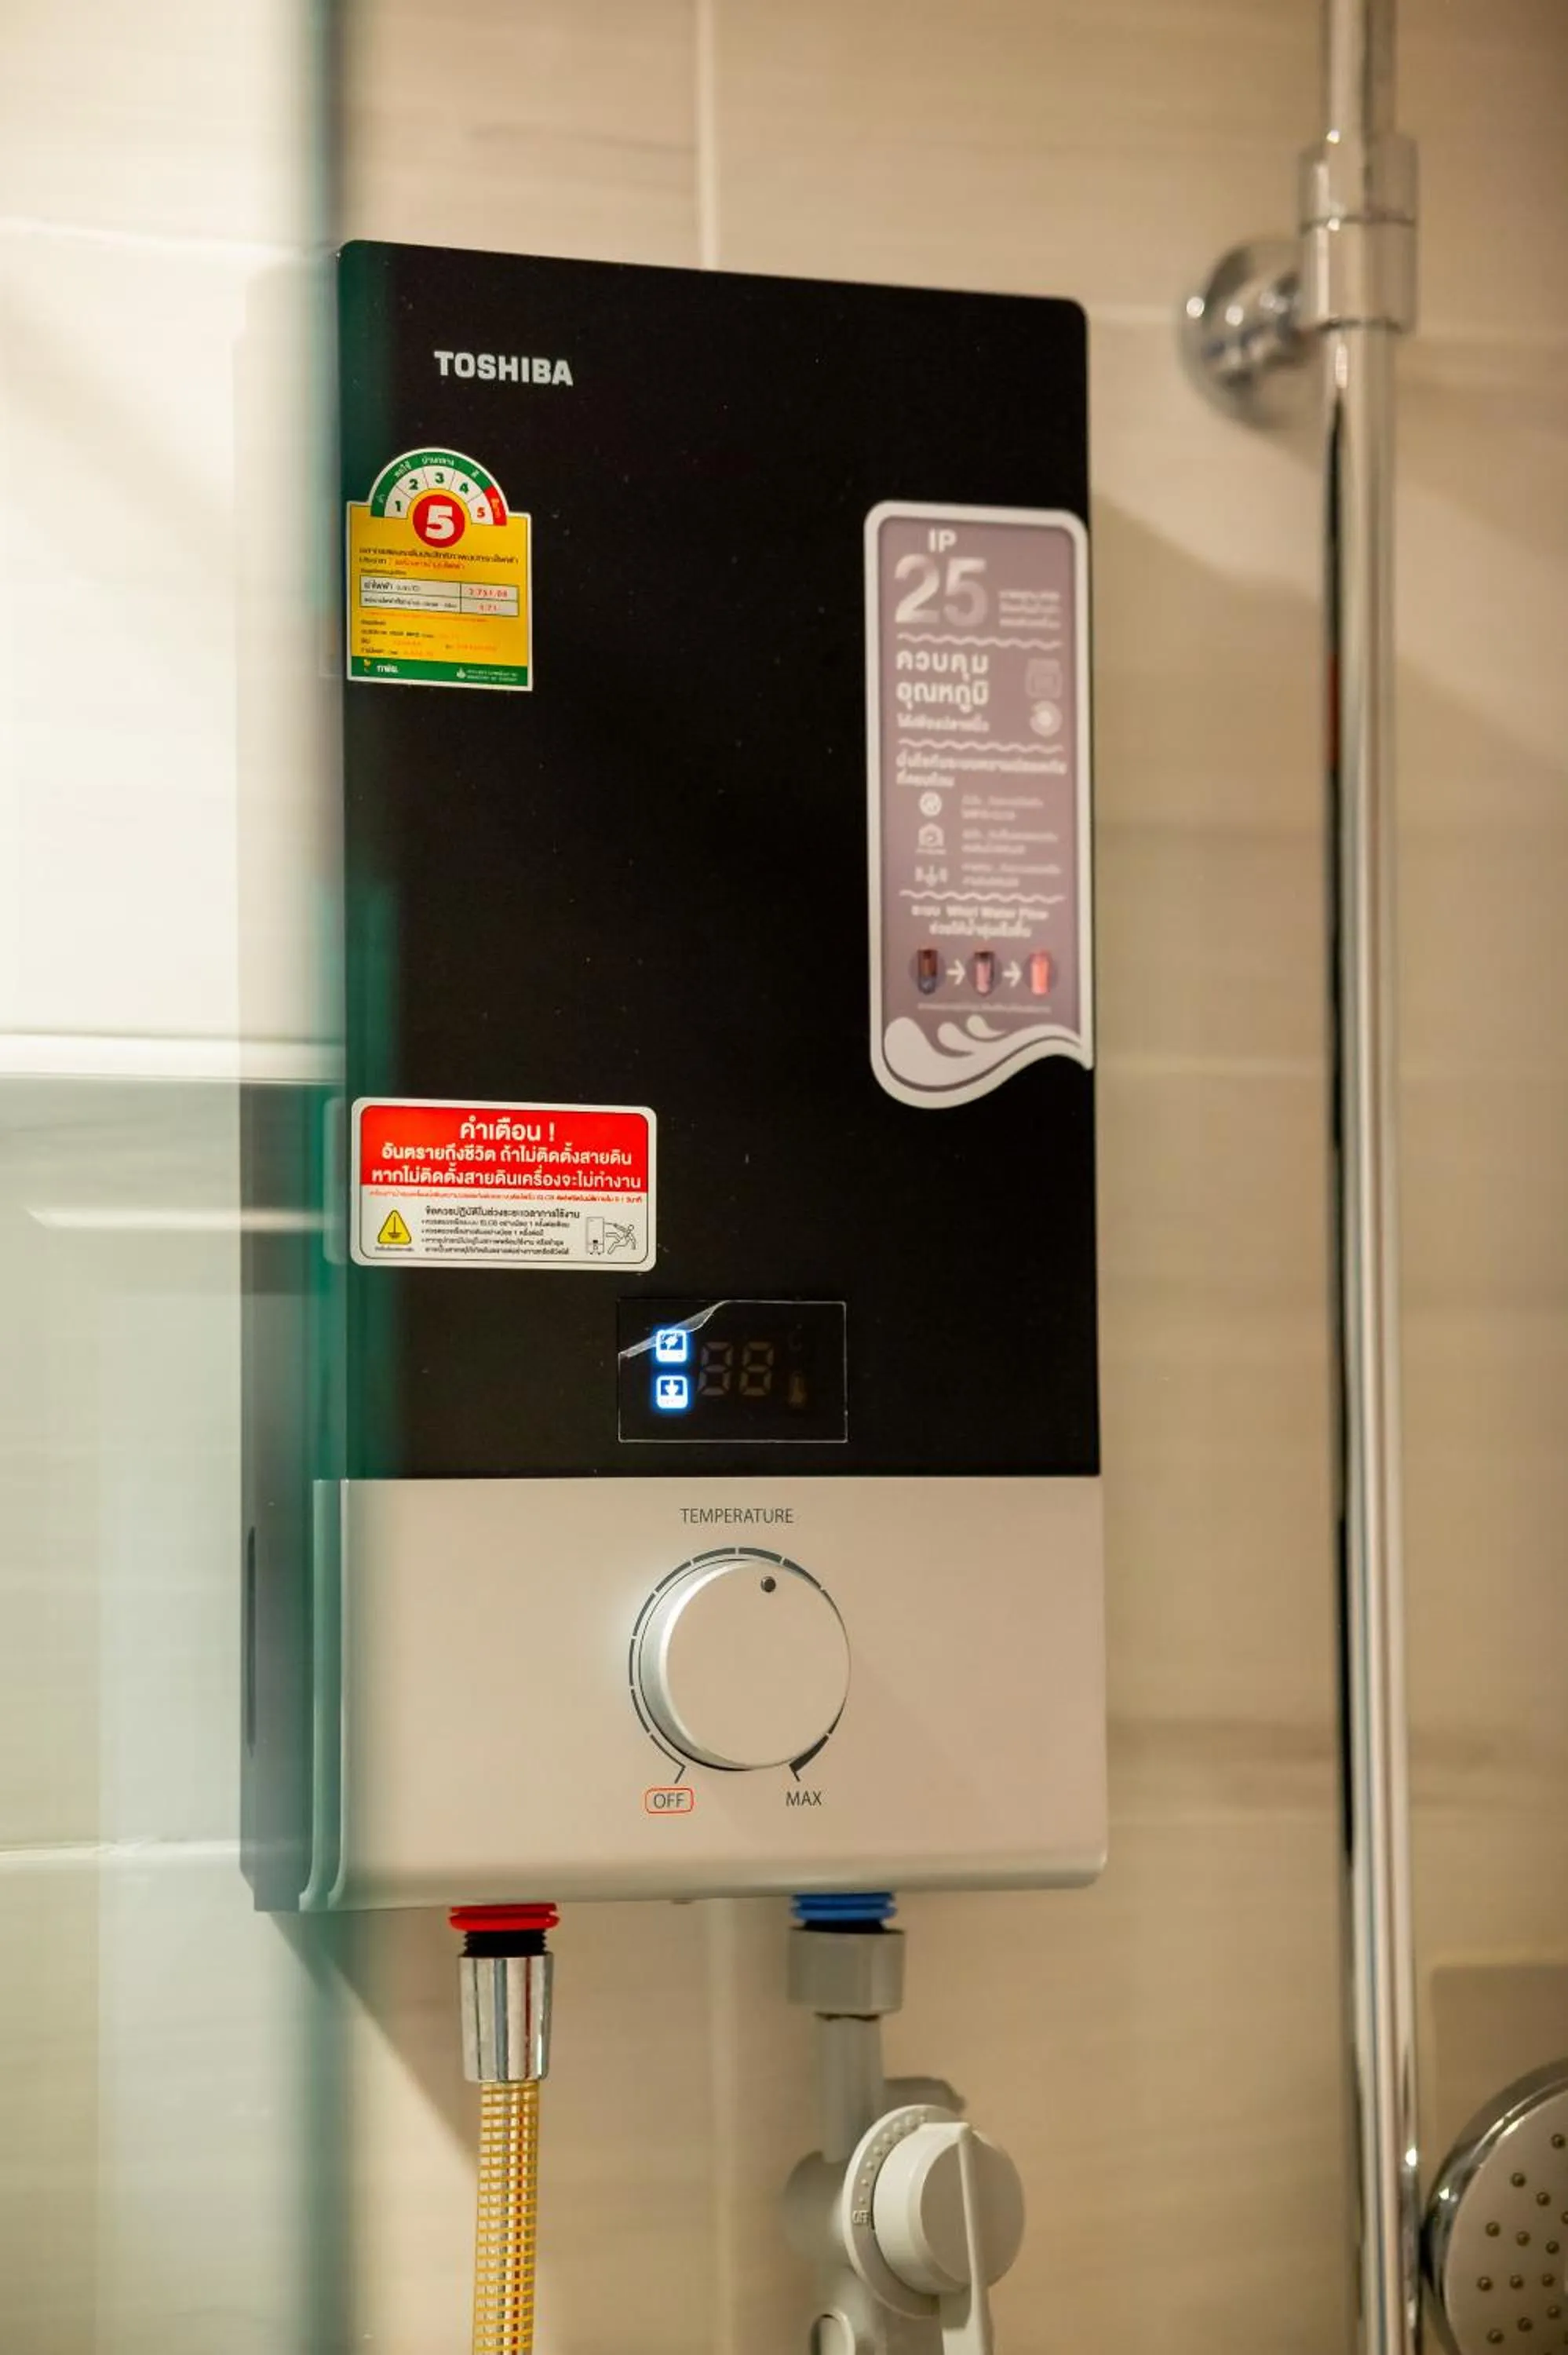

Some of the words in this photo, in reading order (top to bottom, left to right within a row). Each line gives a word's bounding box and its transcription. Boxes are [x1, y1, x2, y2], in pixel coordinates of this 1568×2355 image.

[434, 350, 574, 386] TOSHIBA
[395, 500, 402, 513] 1
[409, 478, 419, 491] 2
[435, 472, 445, 484] 3
[459, 481, 469, 494] 4
[476, 506, 486, 519] 5
[425, 504, 455, 540] 5
[927, 528, 957, 552] IP
[894, 553, 989, 627] 25
[896, 650, 989, 681] ควบคุม
[896, 681, 990, 713] อุณหภูมิ
[460, 1115, 542, 1141] คำเตือน
[549, 1122, 556, 1142] !
[381, 1141, 496, 1162] อันตรายถึงชีวิต
[500, 1142, 633, 1166] ถ้าไม่ติดตั้งสายดิน
[371, 1162, 642, 1189] หากไม่ติดตั้งสายดินเครื่องจะไม่ทำงาน
[680, 1507, 794, 1524] TEMPERATURE
[652, 1792, 685, 1809] OFF
[785, 1791, 822, 1806] MAX
